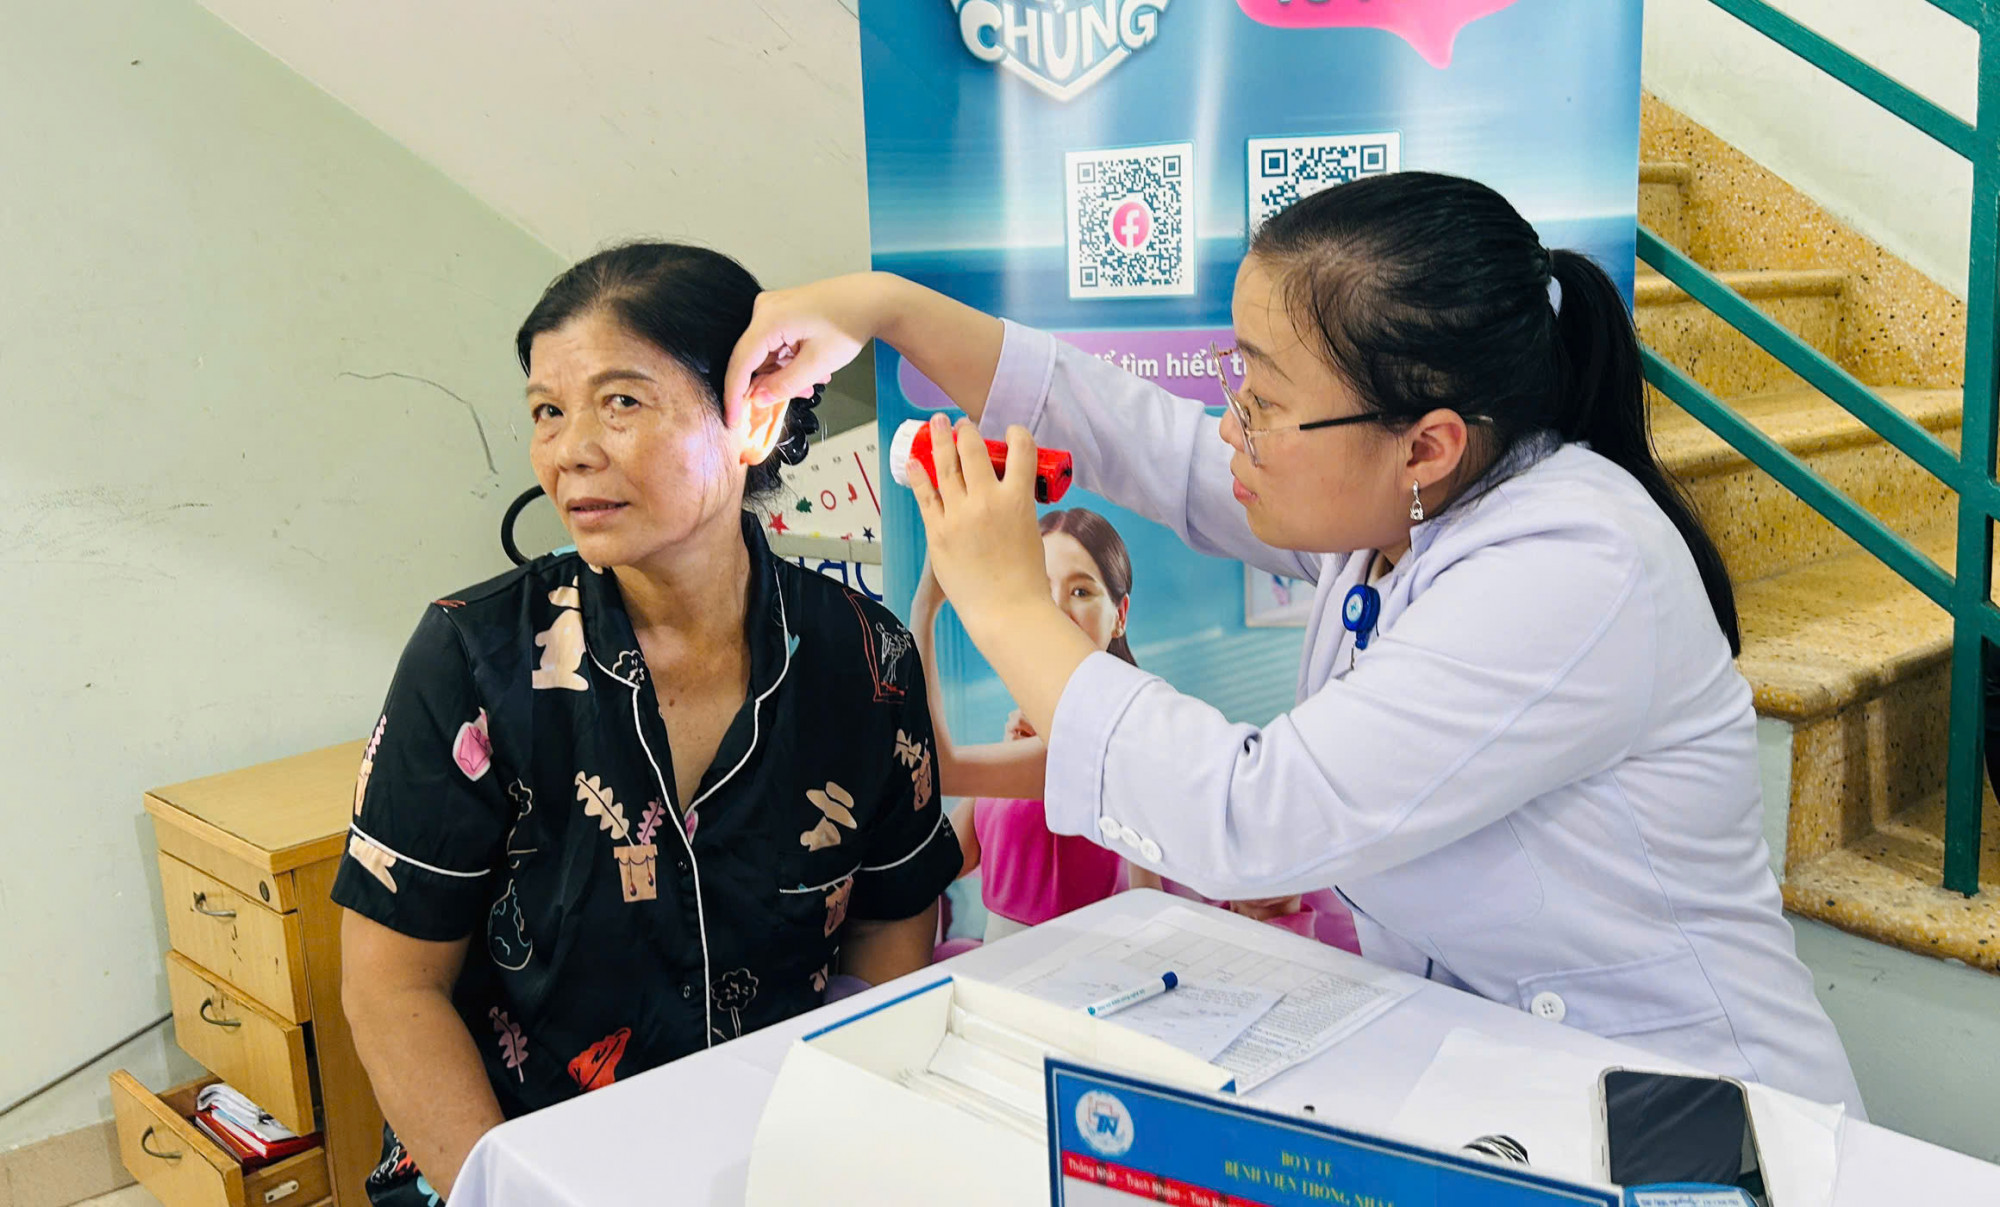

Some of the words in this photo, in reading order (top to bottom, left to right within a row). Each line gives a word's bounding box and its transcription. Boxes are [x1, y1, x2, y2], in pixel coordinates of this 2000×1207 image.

[960, 0, 1166, 80] CHỦNG
[1120, 352, 1159, 377] tìm
[1166, 348, 1219, 377] hiểu
